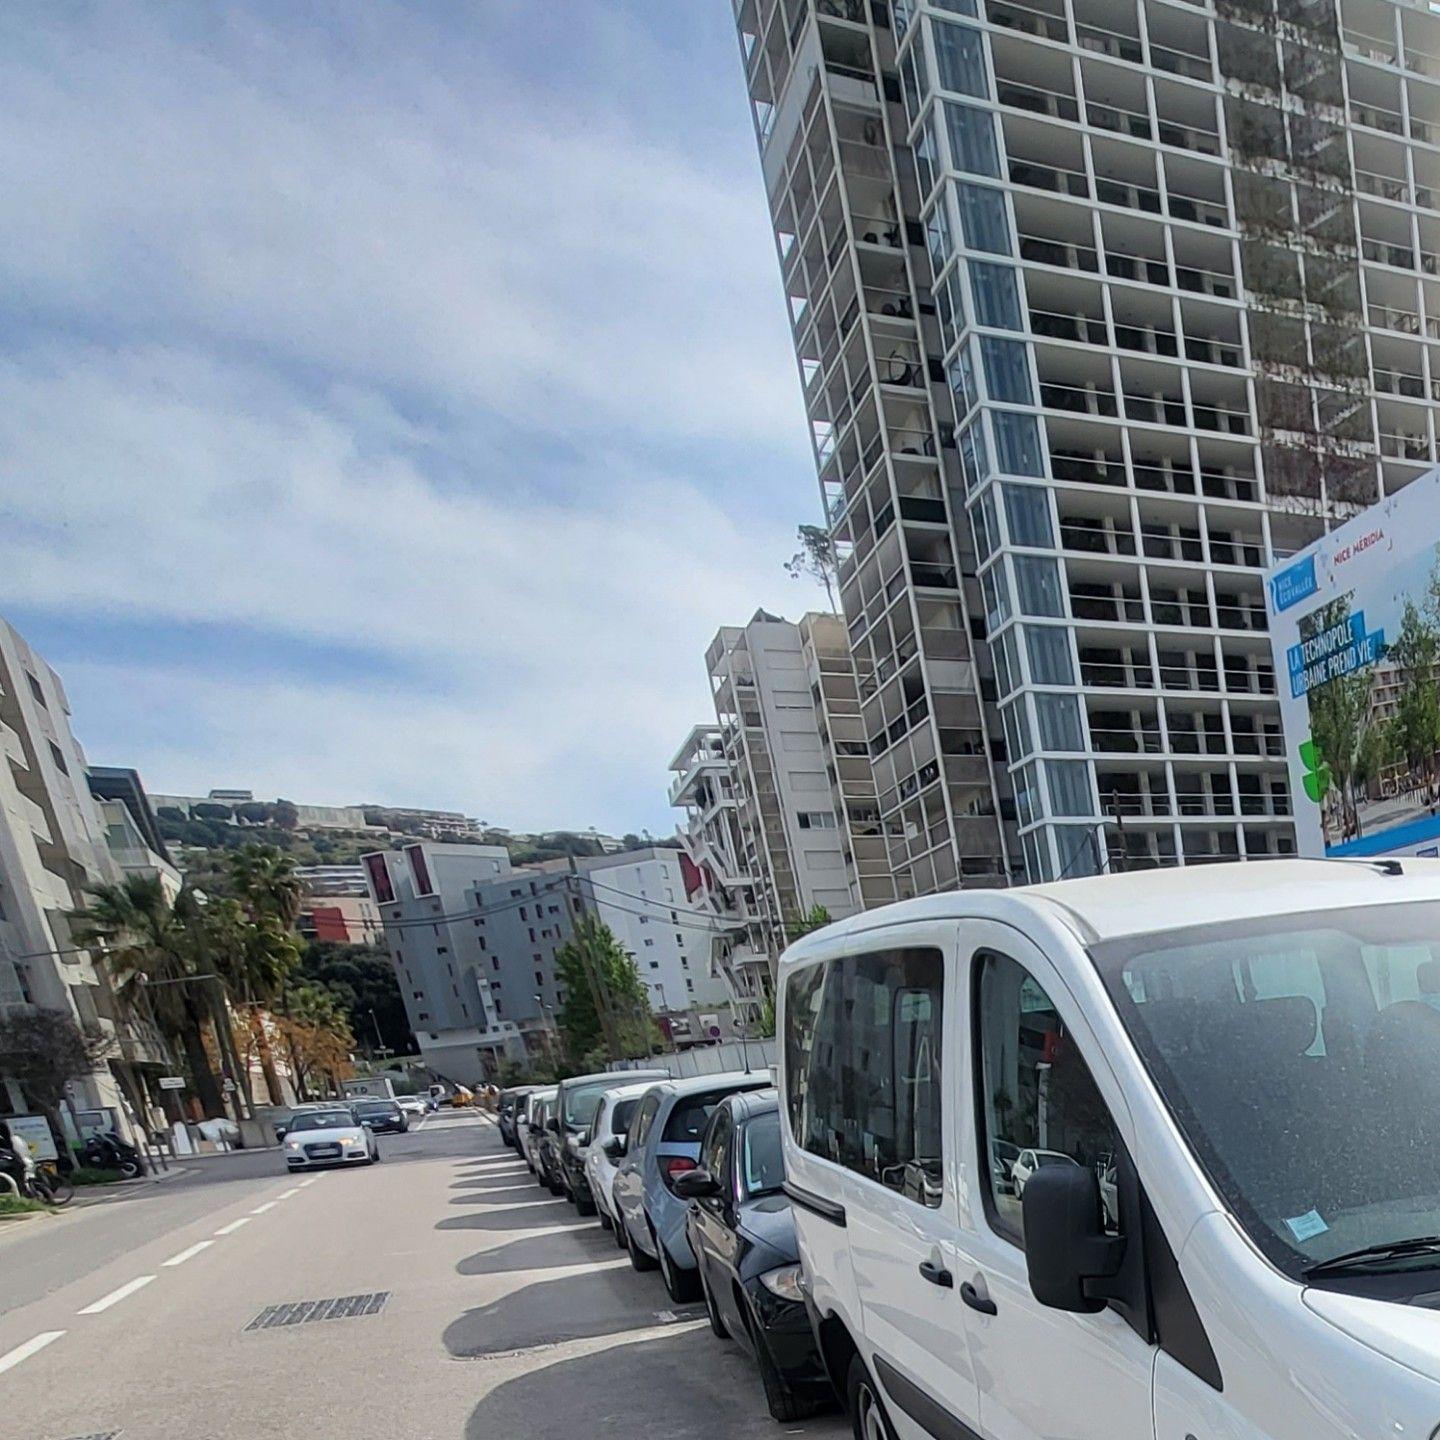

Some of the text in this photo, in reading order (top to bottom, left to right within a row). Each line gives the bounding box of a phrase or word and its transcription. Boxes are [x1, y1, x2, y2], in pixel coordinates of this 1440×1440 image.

[1333, 528, 1385, 566] NICE MÉRIDIA
[1289, 649, 1301, 672] LA
[1293, 638, 1374, 695] URBAINE PREND VIE
